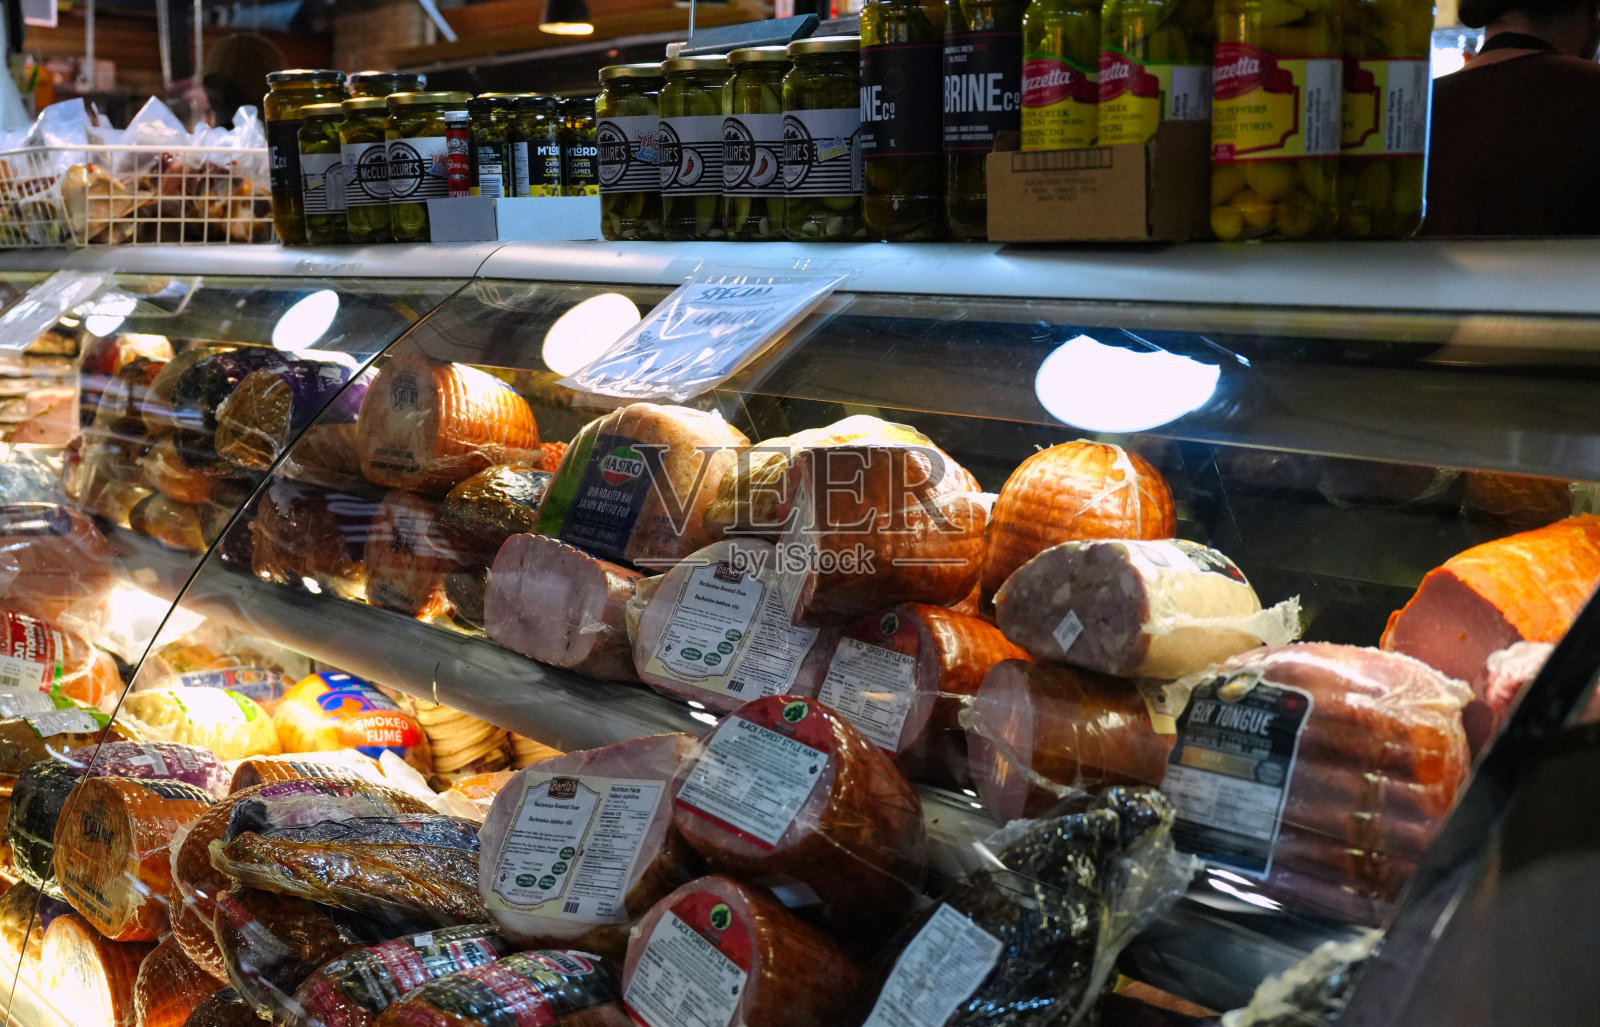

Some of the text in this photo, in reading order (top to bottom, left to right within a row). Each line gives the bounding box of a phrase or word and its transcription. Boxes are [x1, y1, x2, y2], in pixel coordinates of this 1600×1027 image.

[944, 73, 1003, 113] BRINE
[603, 455, 643, 477] MASTRO
[355, 716, 408, 730] SMOKED
[1215, 704, 1275, 736] TONGUE
[738, 720, 819, 758] BLACK FOREST STYLE HAM
[672, 917, 689, 935] BLACK
[689, 929, 709, 951] FOREST
[709, 946, 726, 967] STYLE
